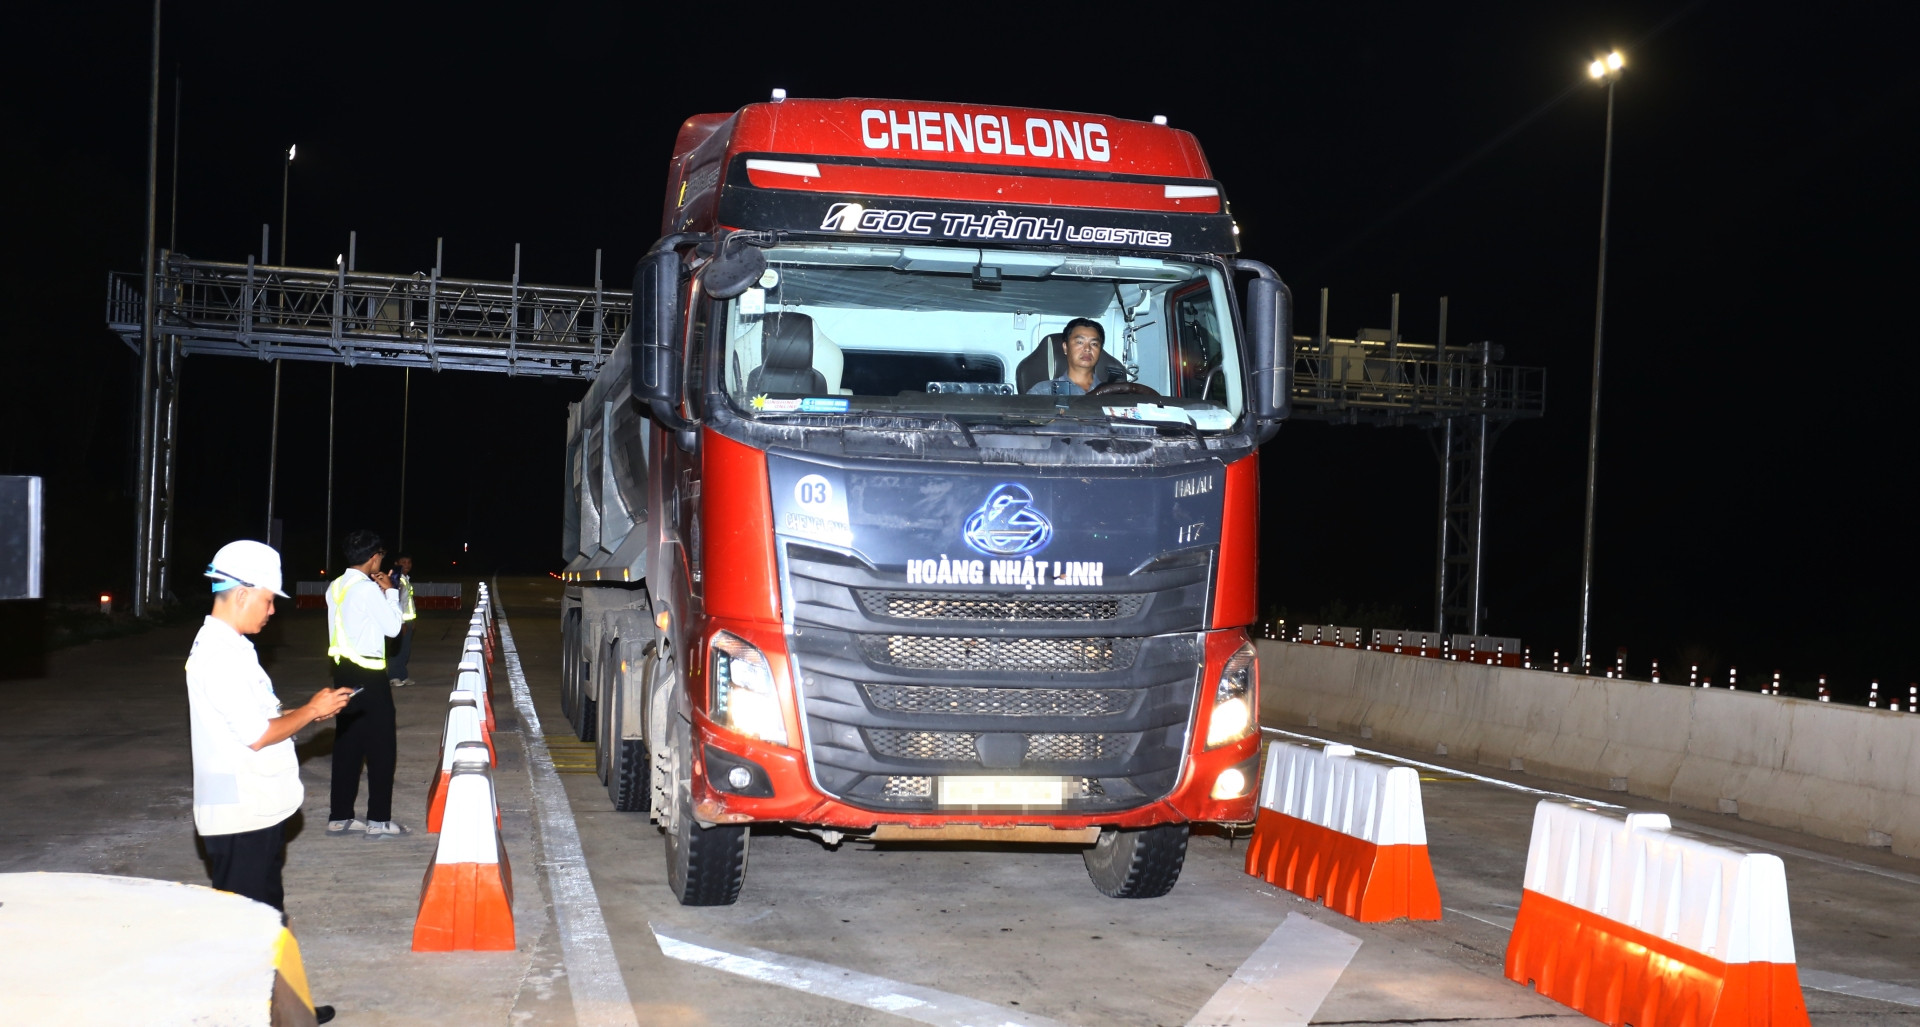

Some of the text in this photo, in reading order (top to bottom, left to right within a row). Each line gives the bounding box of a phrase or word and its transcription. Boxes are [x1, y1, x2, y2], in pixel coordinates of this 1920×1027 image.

[861, 109, 1111, 162] CHENGLONG
[941, 210, 1064, 240] THÀNH
[1066, 226, 1172, 247] LOGISTICS
[800, 482, 826, 504] 03
[1178, 522, 1205, 544] H7
[907, 553, 1104, 590] HOÀNG NHẬT LINH
